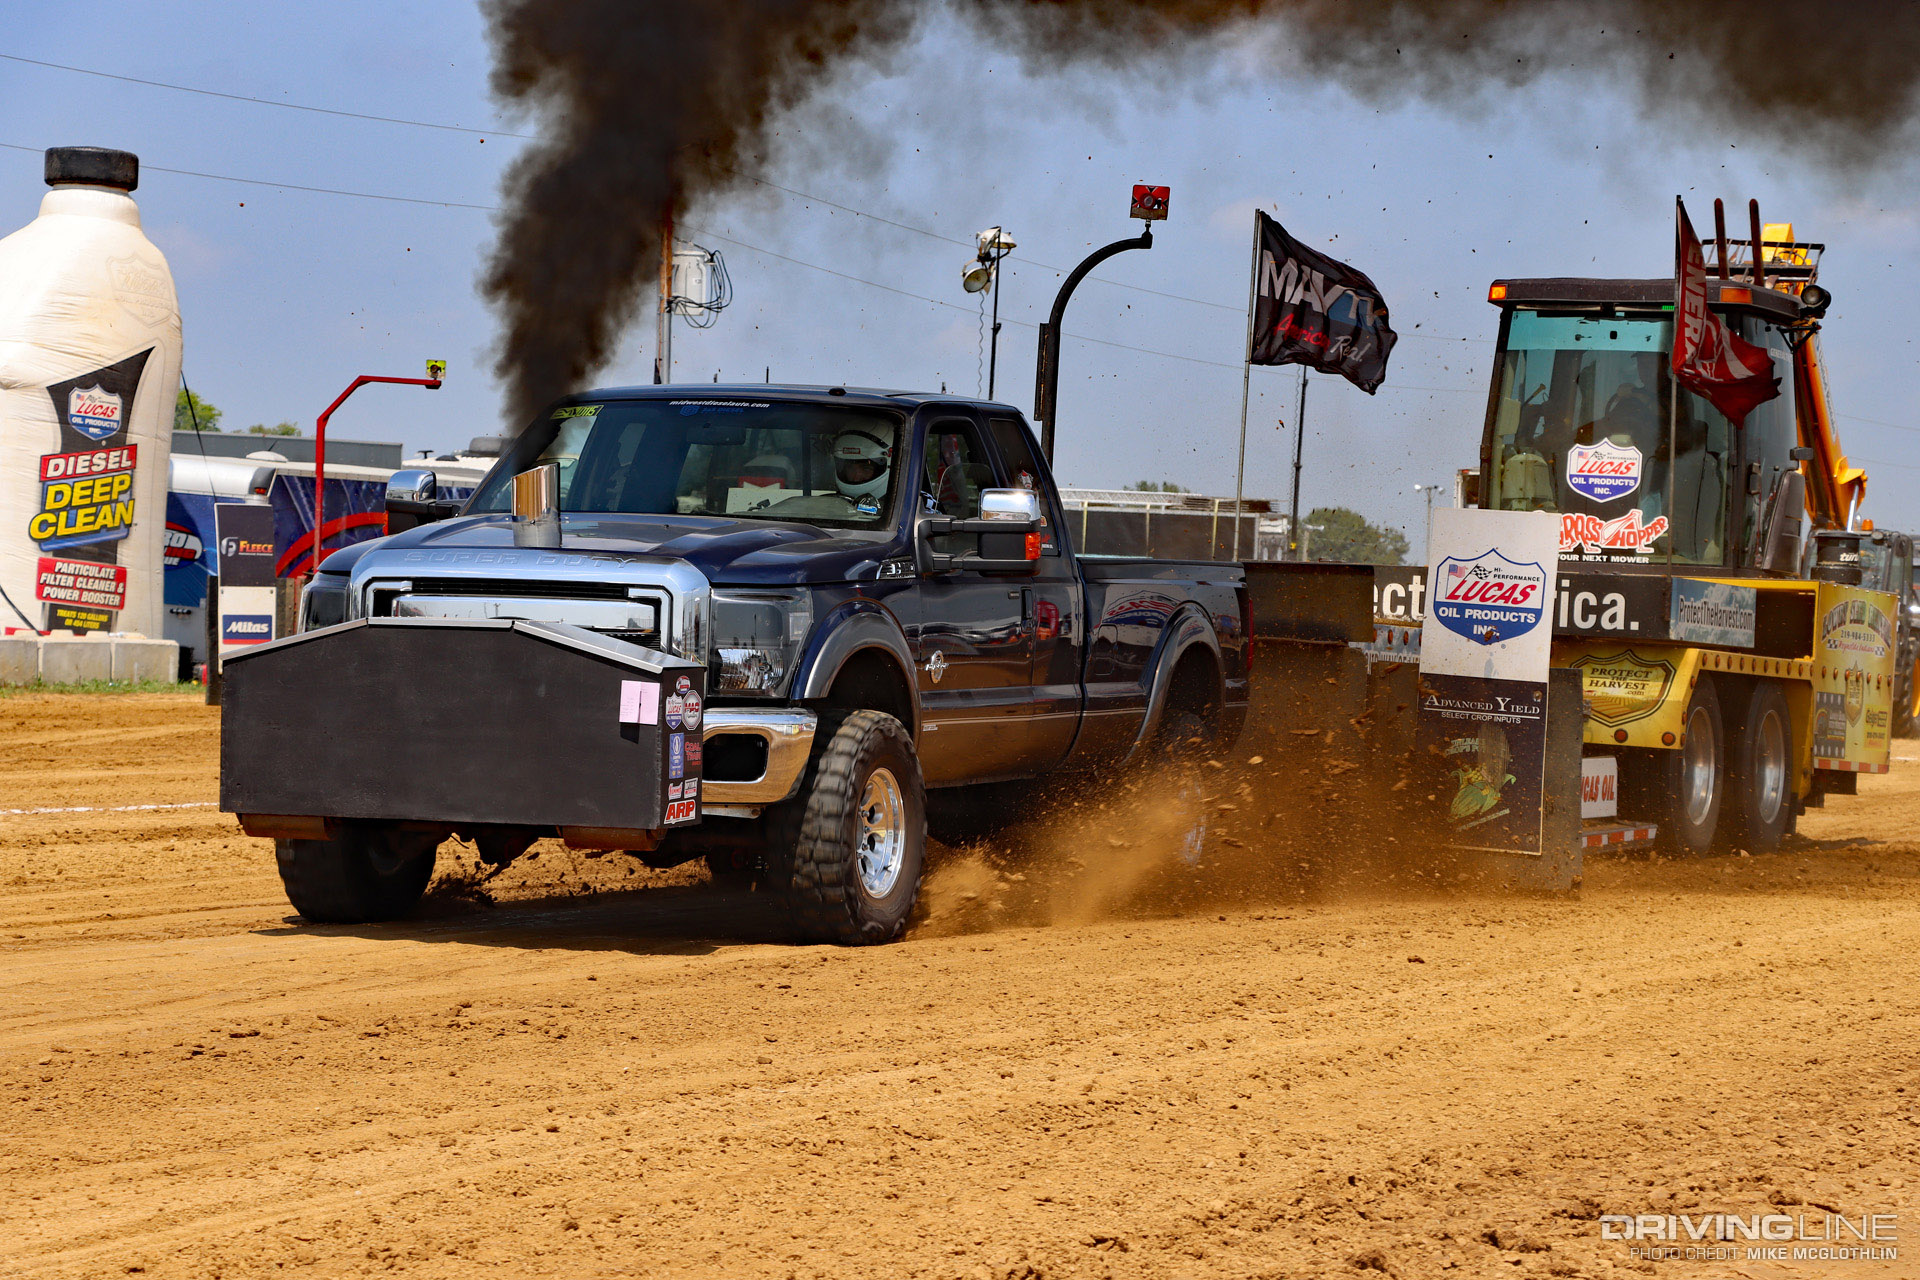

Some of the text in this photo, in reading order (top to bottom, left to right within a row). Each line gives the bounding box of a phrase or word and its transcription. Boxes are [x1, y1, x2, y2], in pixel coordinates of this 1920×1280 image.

[75, 402, 118, 418] LUCAS
[71, 416, 118, 429] OIL PRODUCTS
[46, 449, 132, 478] DIESEL
[1577, 460, 1636, 476] LUCAS
[1571, 476, 1636, 487] OIL PRODUCTS
[44, 473, 131, 511] DEEP
[1594, 487, 1612, 495] INC.
[29, 499, 135, 540] CLEAN
[239, 540, 274, 553] FLEECE
[404, 550, 638, 569] SUPER DUTY
[1611, 556, 1650, 564] MOWER
[54, 561, 117, 580] PARTICULATE
[1493, 573, 1541, 582] PERFORMANCE
[39, 572, 125, 594] FILTER CLEANER &
[1445, 579, 1537, 605] LUCAS
[42, 586, 121, 607] POWER BOOSTER
[1438, 606, 1536, 624] OIL PRODUCTS
[1679, 596, 1754, 631] ProtectTheHarvest.com
[226, 620, 269, 633] Mitas
[1590, 667, 1653, 679] PROTECT
[1589, 679, 1650, 691] HARVEST
[1425, 694, 1541, 715] ADVANCED YIELD
[1441, 711, 1522, 724] SELECT CROP INPUTS
[1602, 774, 1615, 801] OIL
[665, 800, 695, 821] ARP
